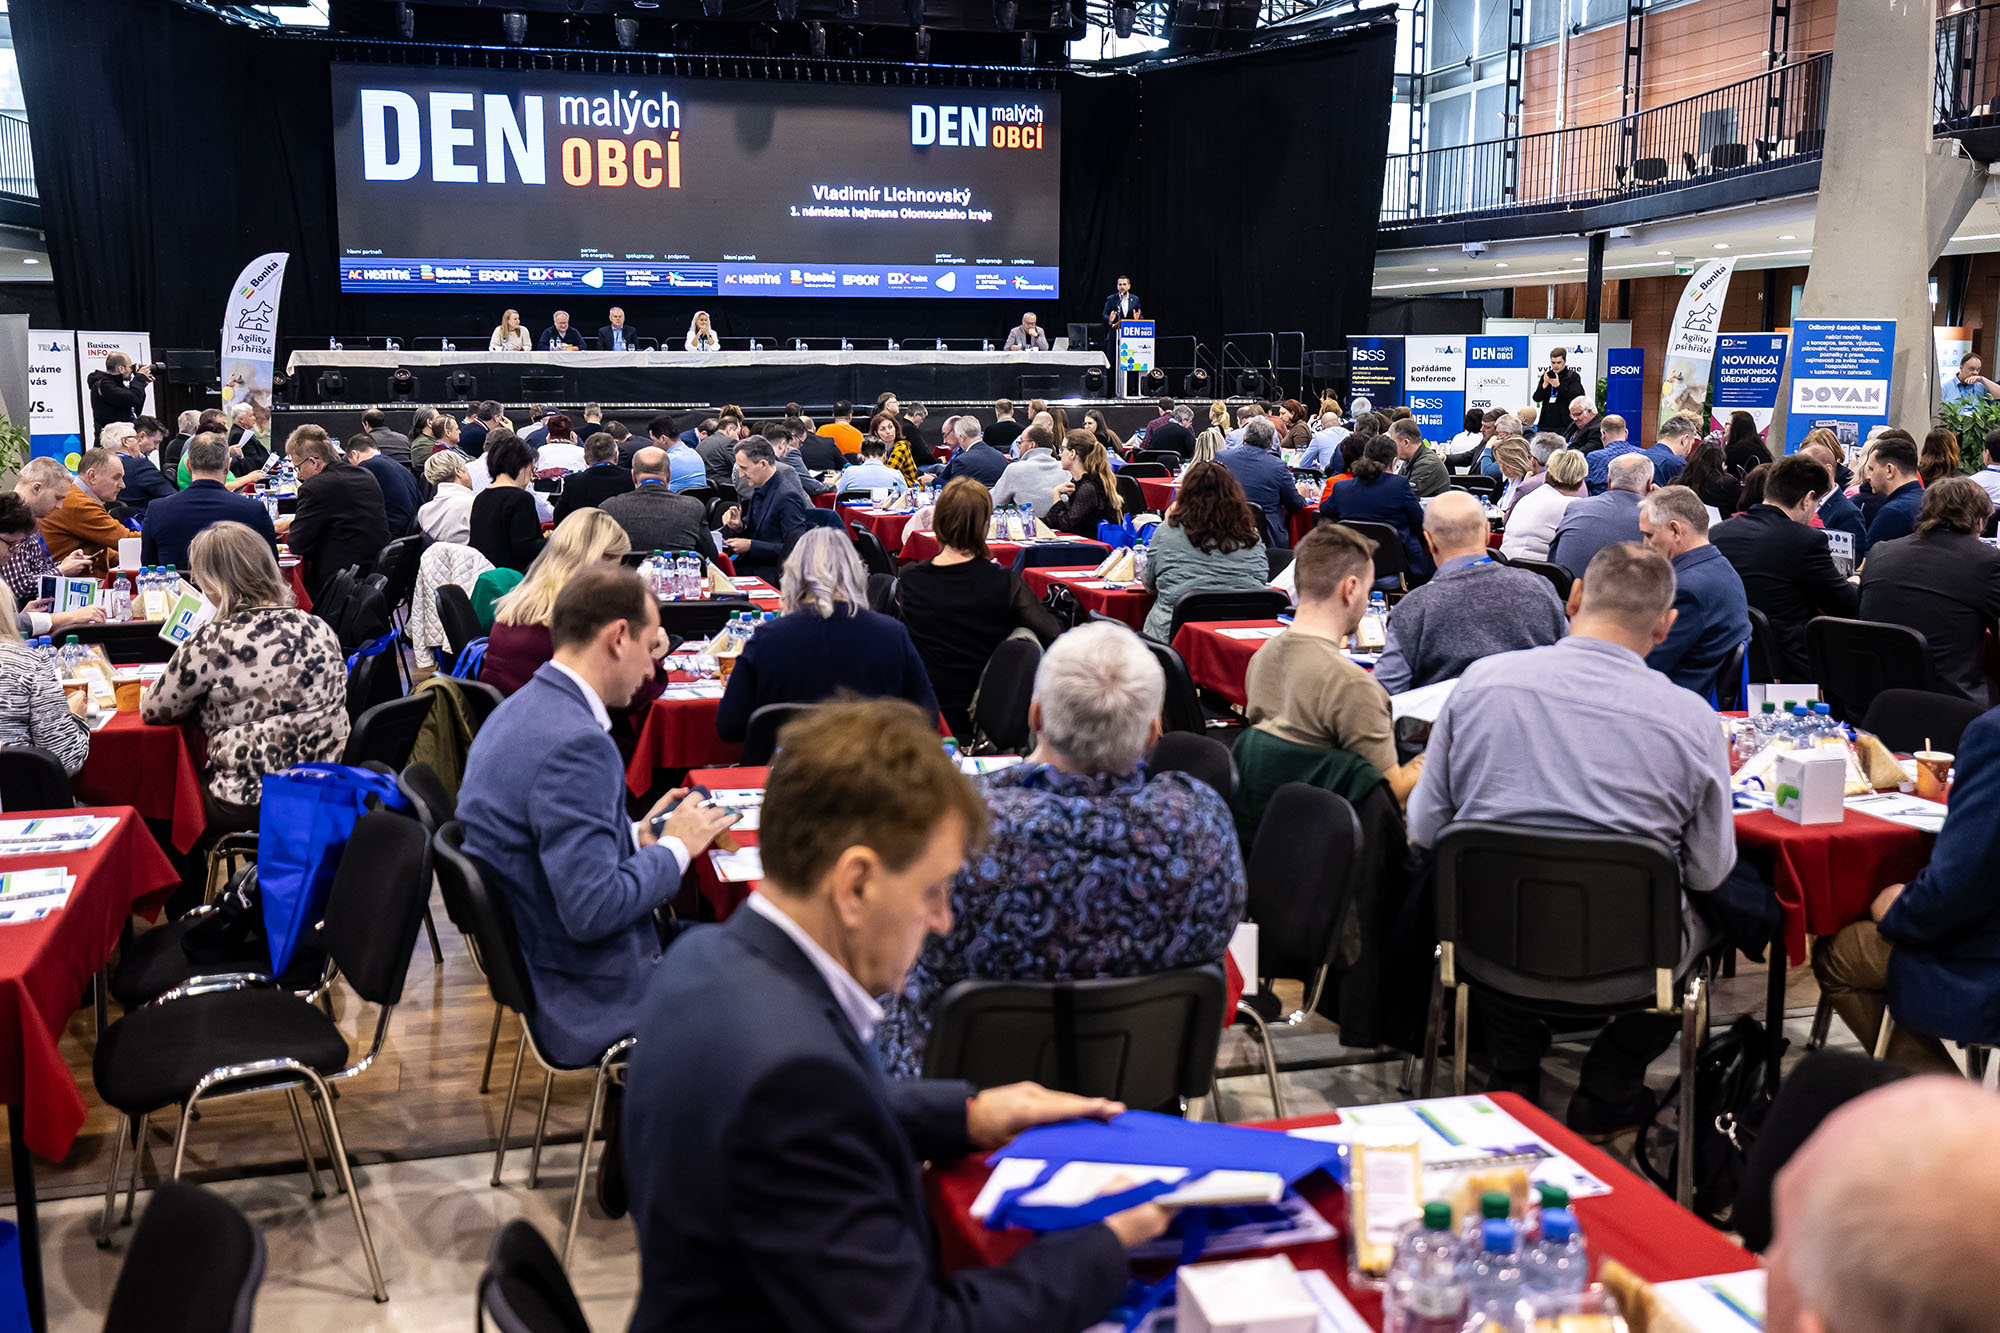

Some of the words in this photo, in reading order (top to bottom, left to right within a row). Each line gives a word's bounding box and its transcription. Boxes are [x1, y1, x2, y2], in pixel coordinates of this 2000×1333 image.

[559, 89, 681, 135] malých
[991, 103, 1044, 124] malých
[911, 104, 987, 147] DEN
[360, 88, 546, 185] DEN
[992, 122, 1044, 149] OBCÍ
[561, 130, 681, 188] OBCÍ
[812, 184, 881, 201] Vladimír
[884, 186, 972, 206] Lichnovský
[790, 206, 801, 217] 1.
[802, 206, 851, 218] náměstek
[852, 206, 899, 220] hejtmana
[900, 207, 967, 220] Olomouckého
[968, 208, 993, 223] kraje
[250, 262, 279, 287] Bonita
[348, 269, 363, 280] AC
[478, 269, 520, 282] EPSON
[724, 274, 737, 284] AC
[842, 274, 880, 286] EPSON
[1699, 266, 1727, 291] Bonita
[1123, 326, 1140, 336] DEN
[237, 333, 268, 345] Agility
[1681, 333, 1709, 344] Agility
[87, 341, 120, 349] Business
[230, 344, 244, 353] psí
[245, 344, 272, 355] hřiště
[1675, 343, 1688, 351] psí
[1688, 344, 1712, 353] hřiště
[1472, 347, 1496, 360] DEN
[1496, 351, 1513, 360] OBCÍ
[1721, 355, 1779, 365] NOVINKA!
[1411, 364, 1452, 373] pořádáme
[1610, 366, 1640, 375] EPSON
[1721, 367, 1778, 375] ELEKTRONICKÁ
[30, 376, 48, 386] vás
[1410, 375, 1456, 383] konference
[1720, 375, 1750, 383] ÚŘEDNÍ
[1801, 386, 1881, 403] SOVAK
